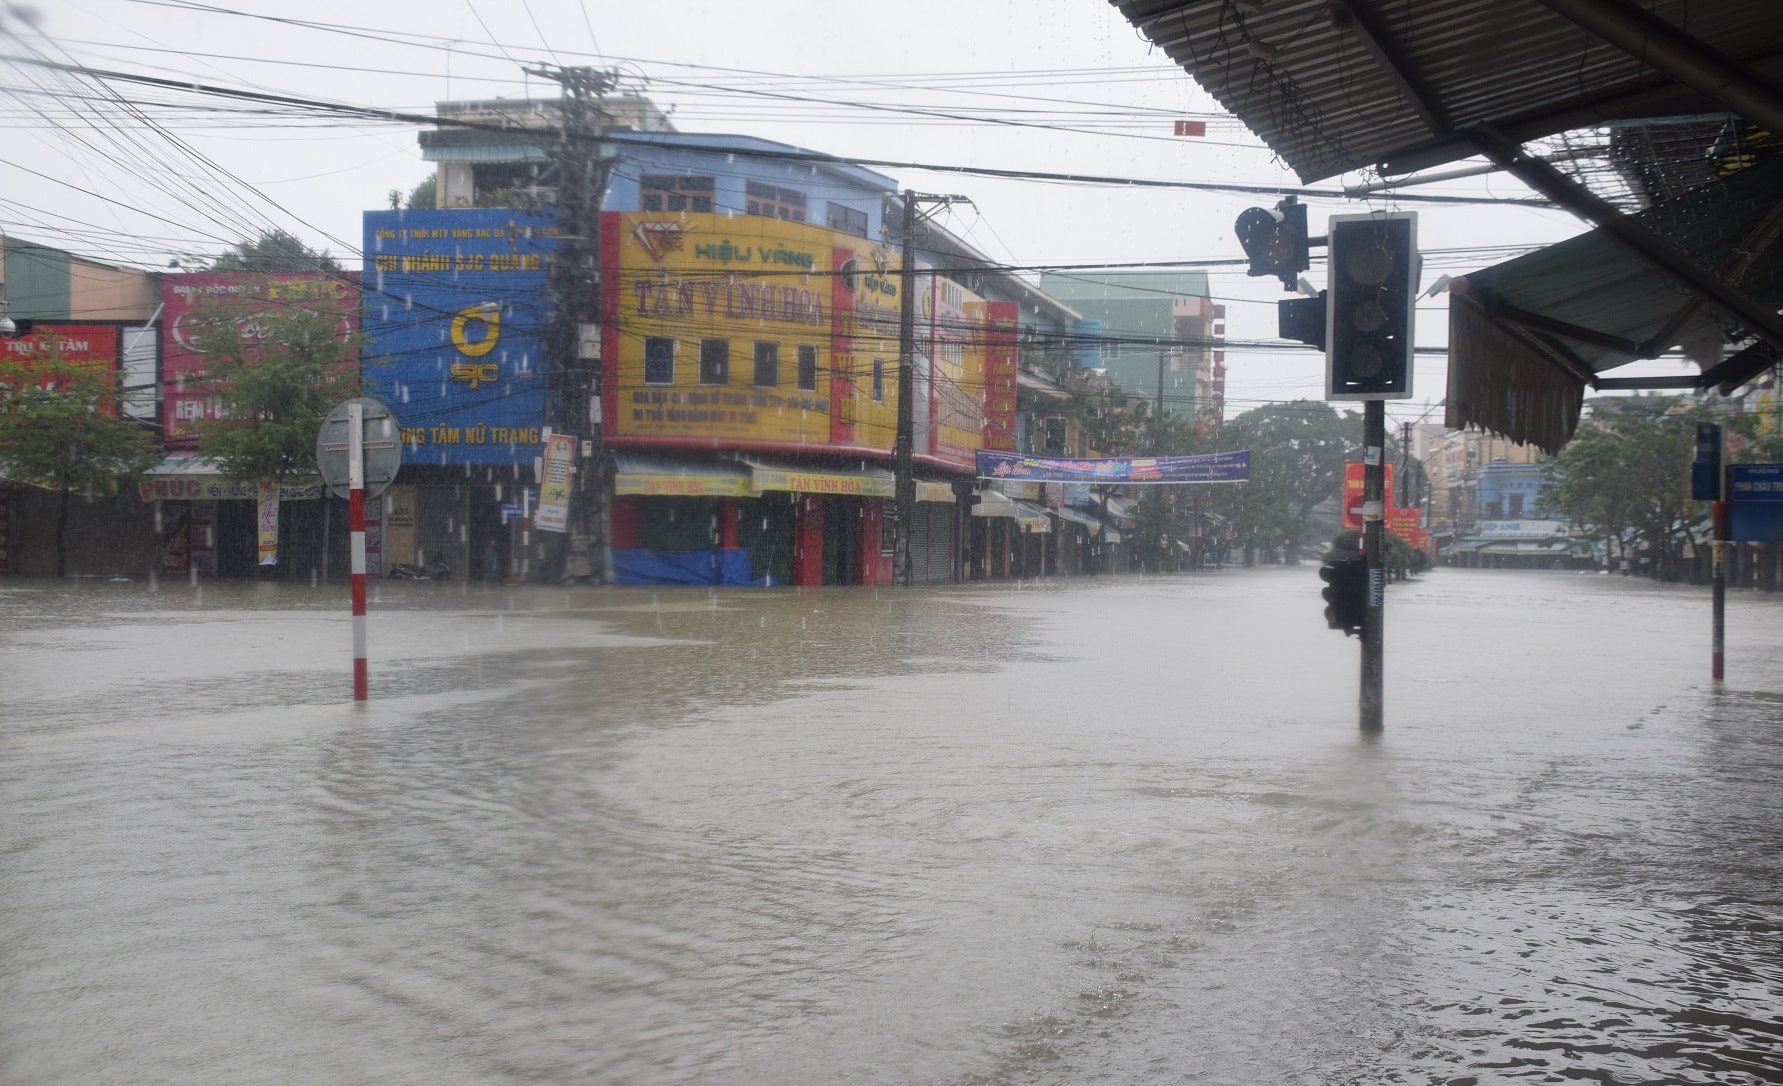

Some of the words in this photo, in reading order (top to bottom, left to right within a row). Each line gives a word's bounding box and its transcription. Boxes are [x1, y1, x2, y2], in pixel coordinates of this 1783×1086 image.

[375, 253, 398, 272] CHI
[402, 250, 450, 272] NHÁNH
[454, 253, 485, 272] SJC
[488, 247, 541, 272] QUẢNG
[695, 239, 752, 265] HIỆU
[758, 243, 815, 268] VÀNG
[57, 338, 89, 352] TÂM
[430, 423, 460, 444] TÂM
[465, 422, 487, 444] NỮ
[491, 427, 539, 444] TRANG
[789, 475, 812, 490] TÂN
[814, 476, 838, 492] VĨNH
